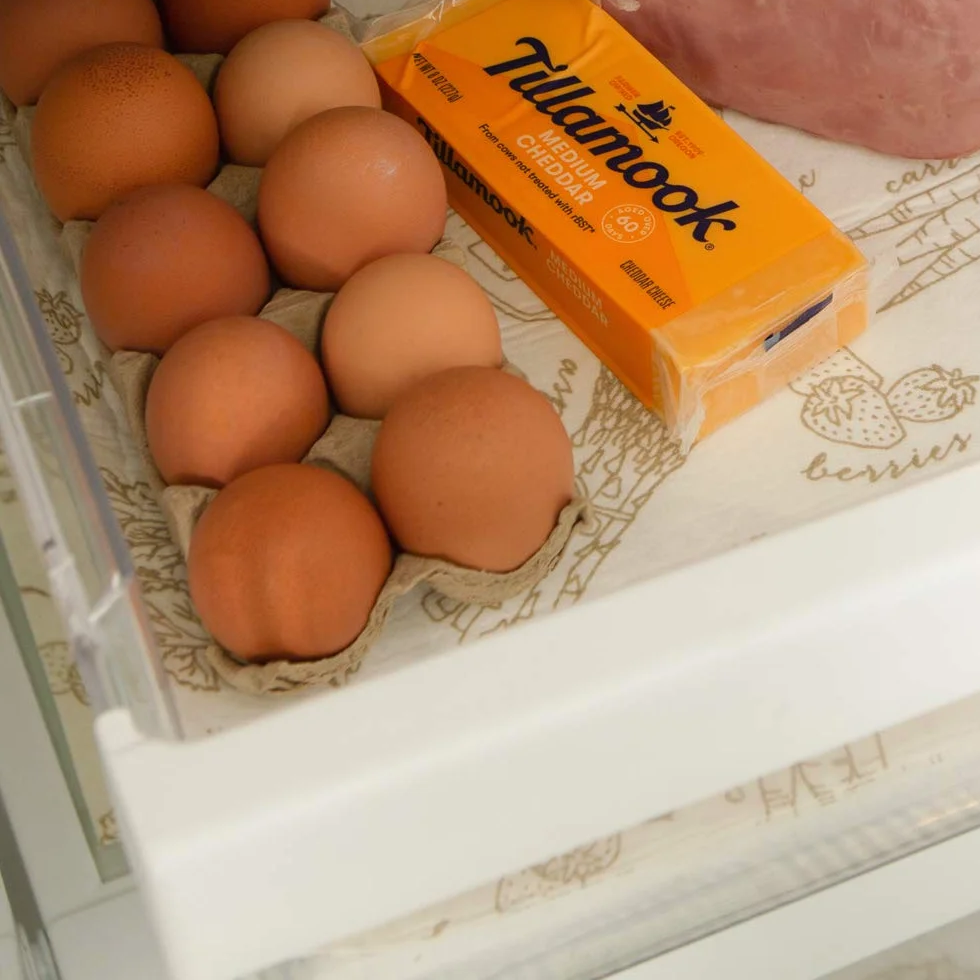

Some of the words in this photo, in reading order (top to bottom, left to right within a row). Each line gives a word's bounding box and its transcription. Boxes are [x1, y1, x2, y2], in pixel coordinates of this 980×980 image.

[479, 123, 499, 143] From
[497, 143, 518, 161] cows
[515, 160, 532, 174] not
[528, 172, 558, 199] treated
[555, 197, 573, 215] with
[483, 36, 740, 243] Tillamook
[516, 135, 594, 205] CHEDDAR
[538, 129, 607, 190] MEDIUM
[616, 216, 639, 232] 60
[546, 258, 608, 328] CHEDDAR
[549, 249, 602, 310] MEDIUM
[620, 260, 654, 290] CHEDDAR
[646, 286, 676, 309] CHEESE
[800, 432, 973, 484] berries
